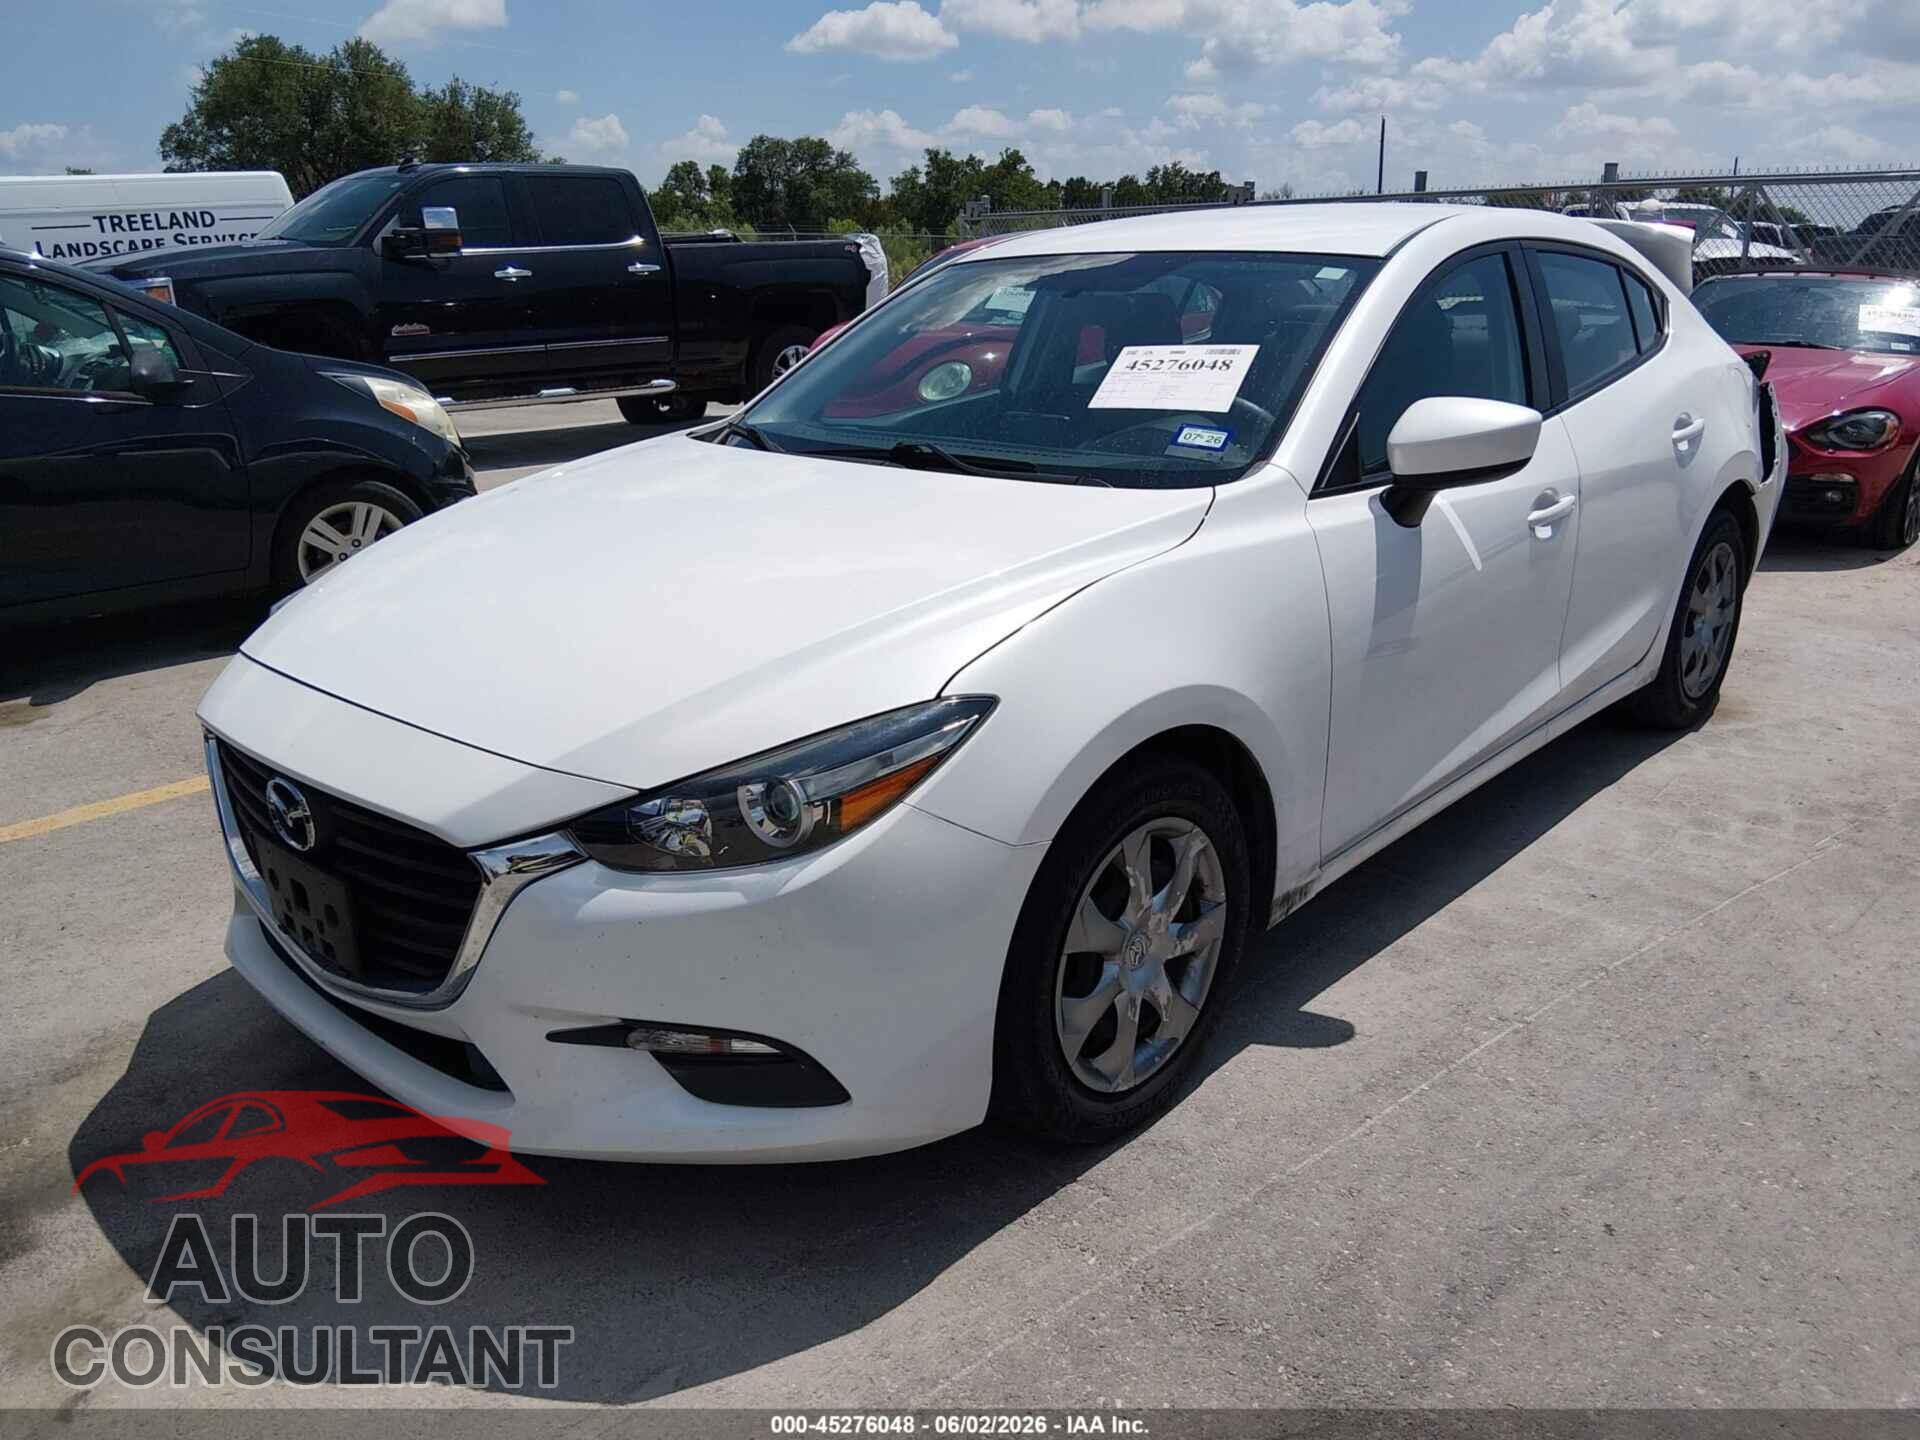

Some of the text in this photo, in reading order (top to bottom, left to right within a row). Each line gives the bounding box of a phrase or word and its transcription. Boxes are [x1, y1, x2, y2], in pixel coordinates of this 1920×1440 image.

[93, 210, 216, 233] TREELAND
[35, 238, 165, 259] LANDSCAPE
[1125, 359, 1234, 371] 45276048
[1183, 432, 1222, 444] 07 26
